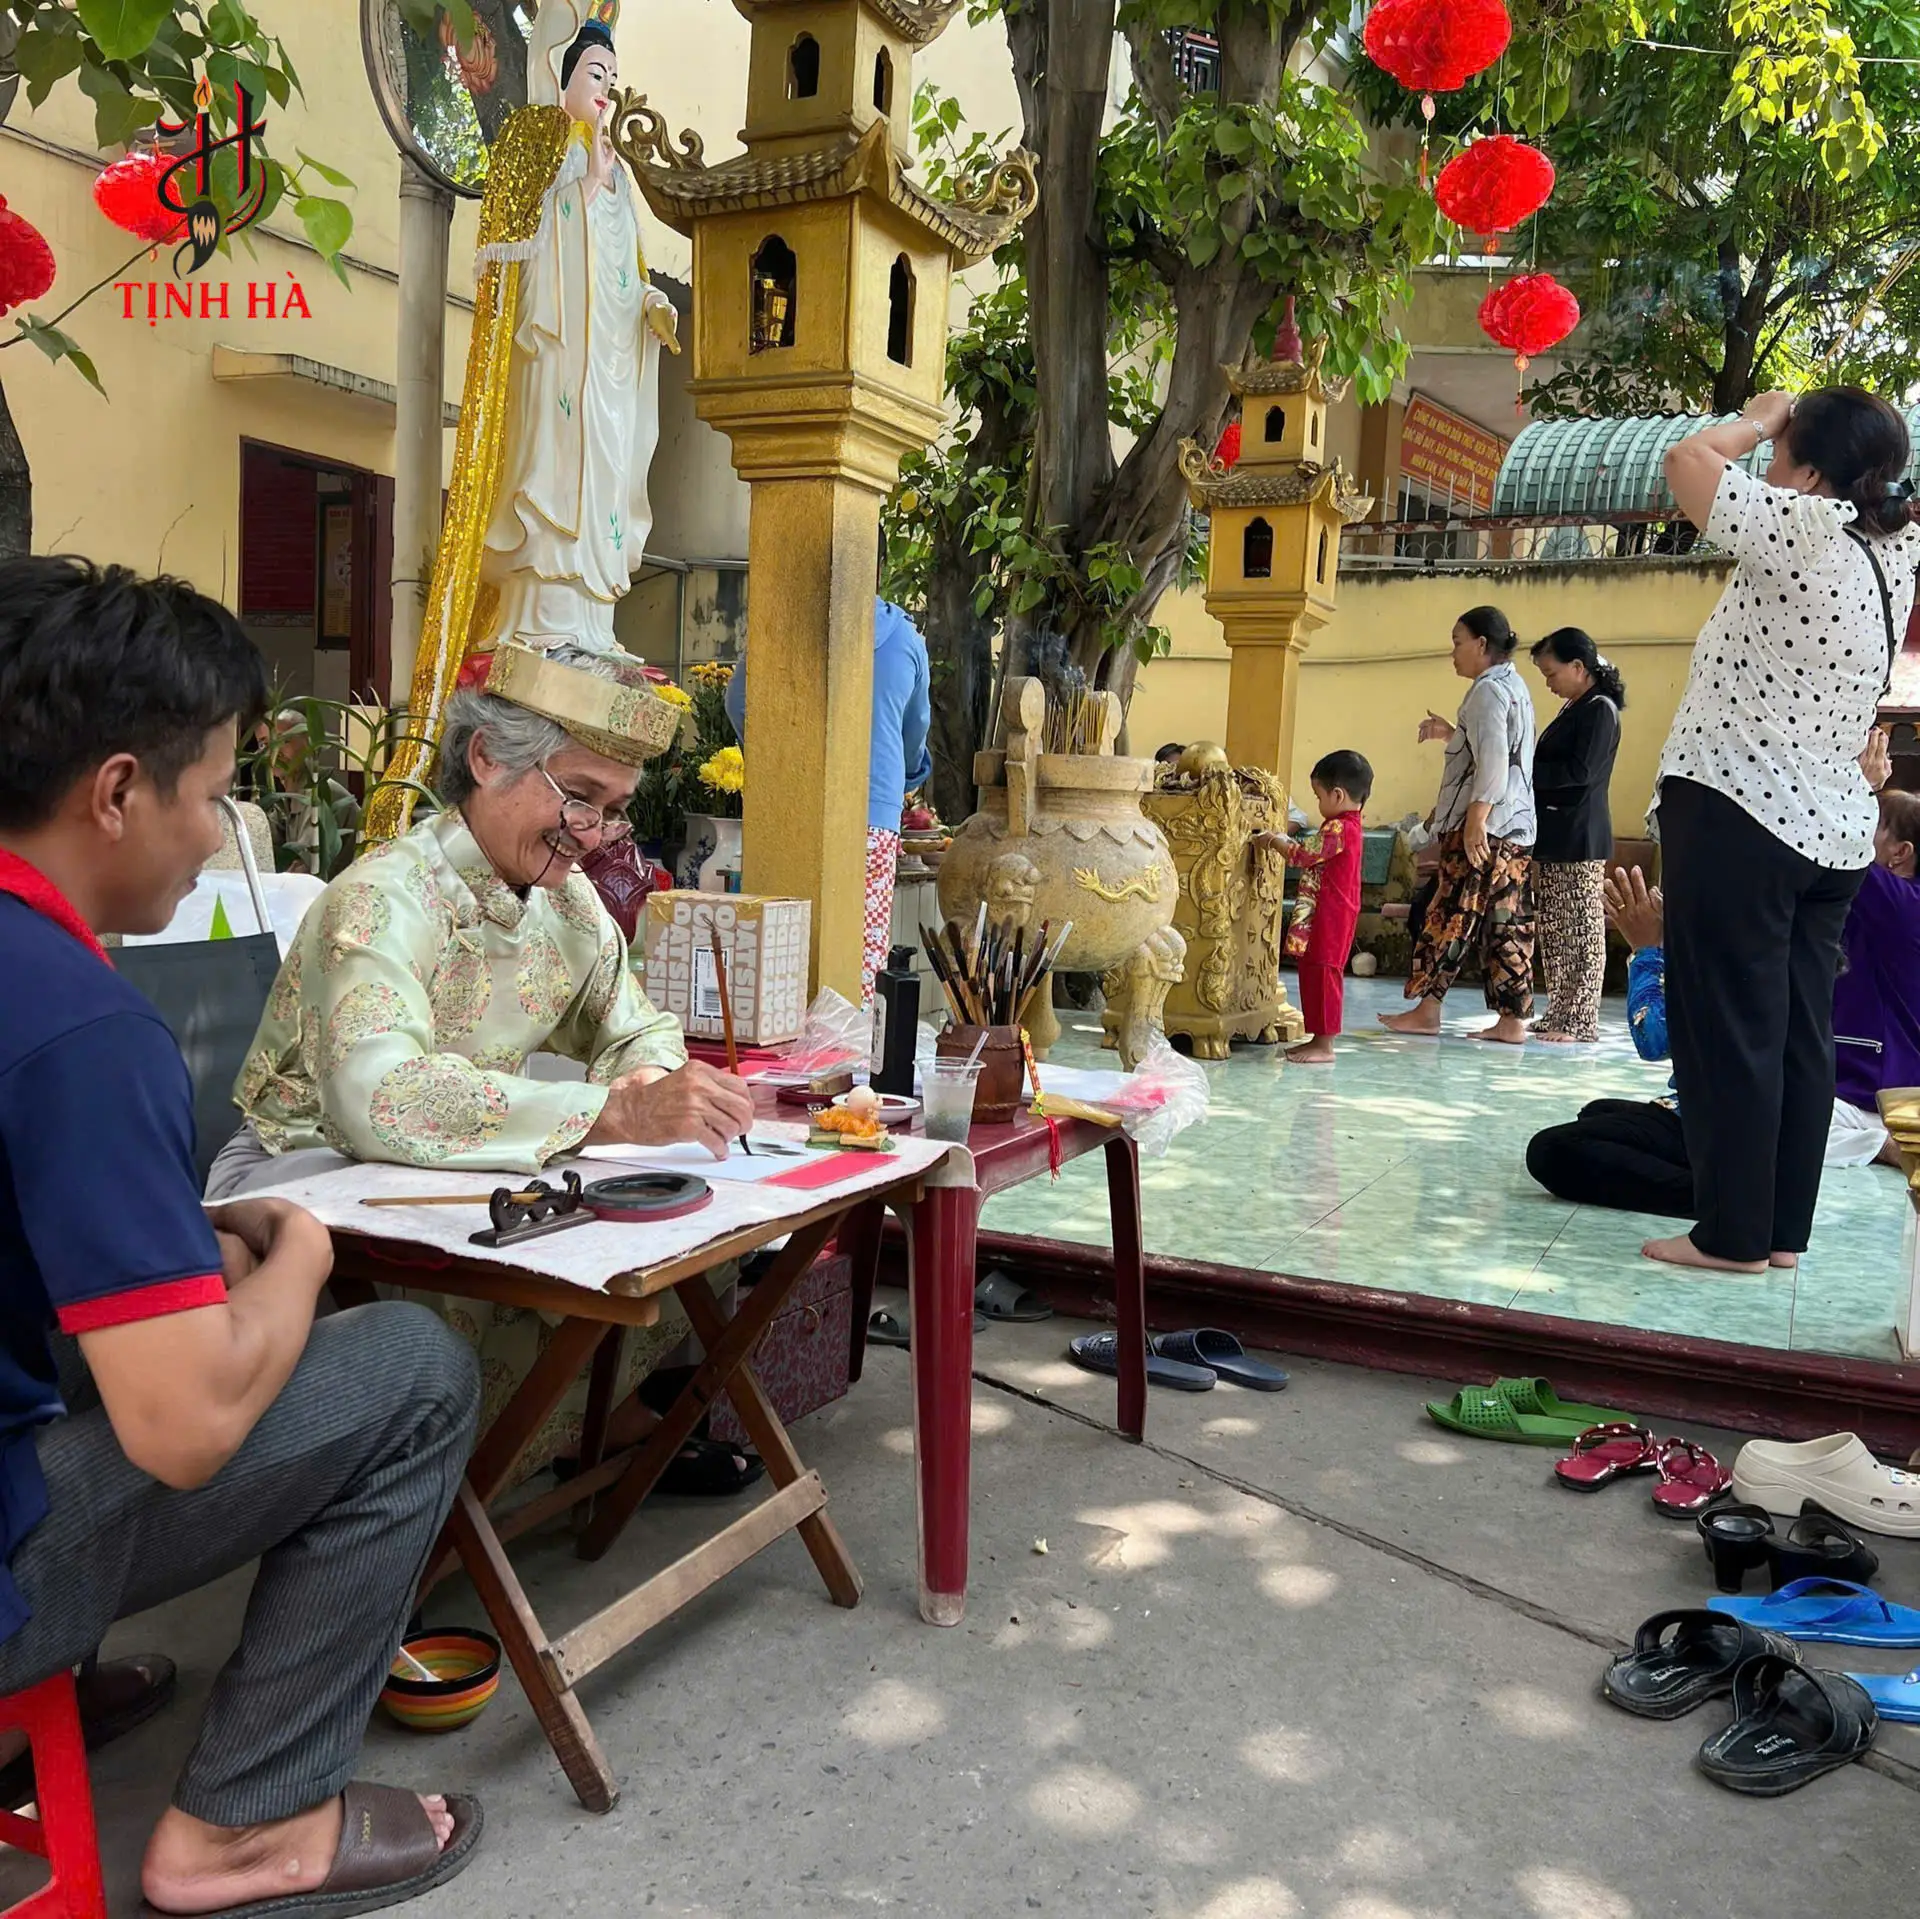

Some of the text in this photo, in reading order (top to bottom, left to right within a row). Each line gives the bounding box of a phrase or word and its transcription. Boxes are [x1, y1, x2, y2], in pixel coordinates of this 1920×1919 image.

[761, 908, 778, 1036] OATSIDE
[773, 908, 789, 1034] OATSIDE
[785, 906, 801, 1032] OATSIDE
